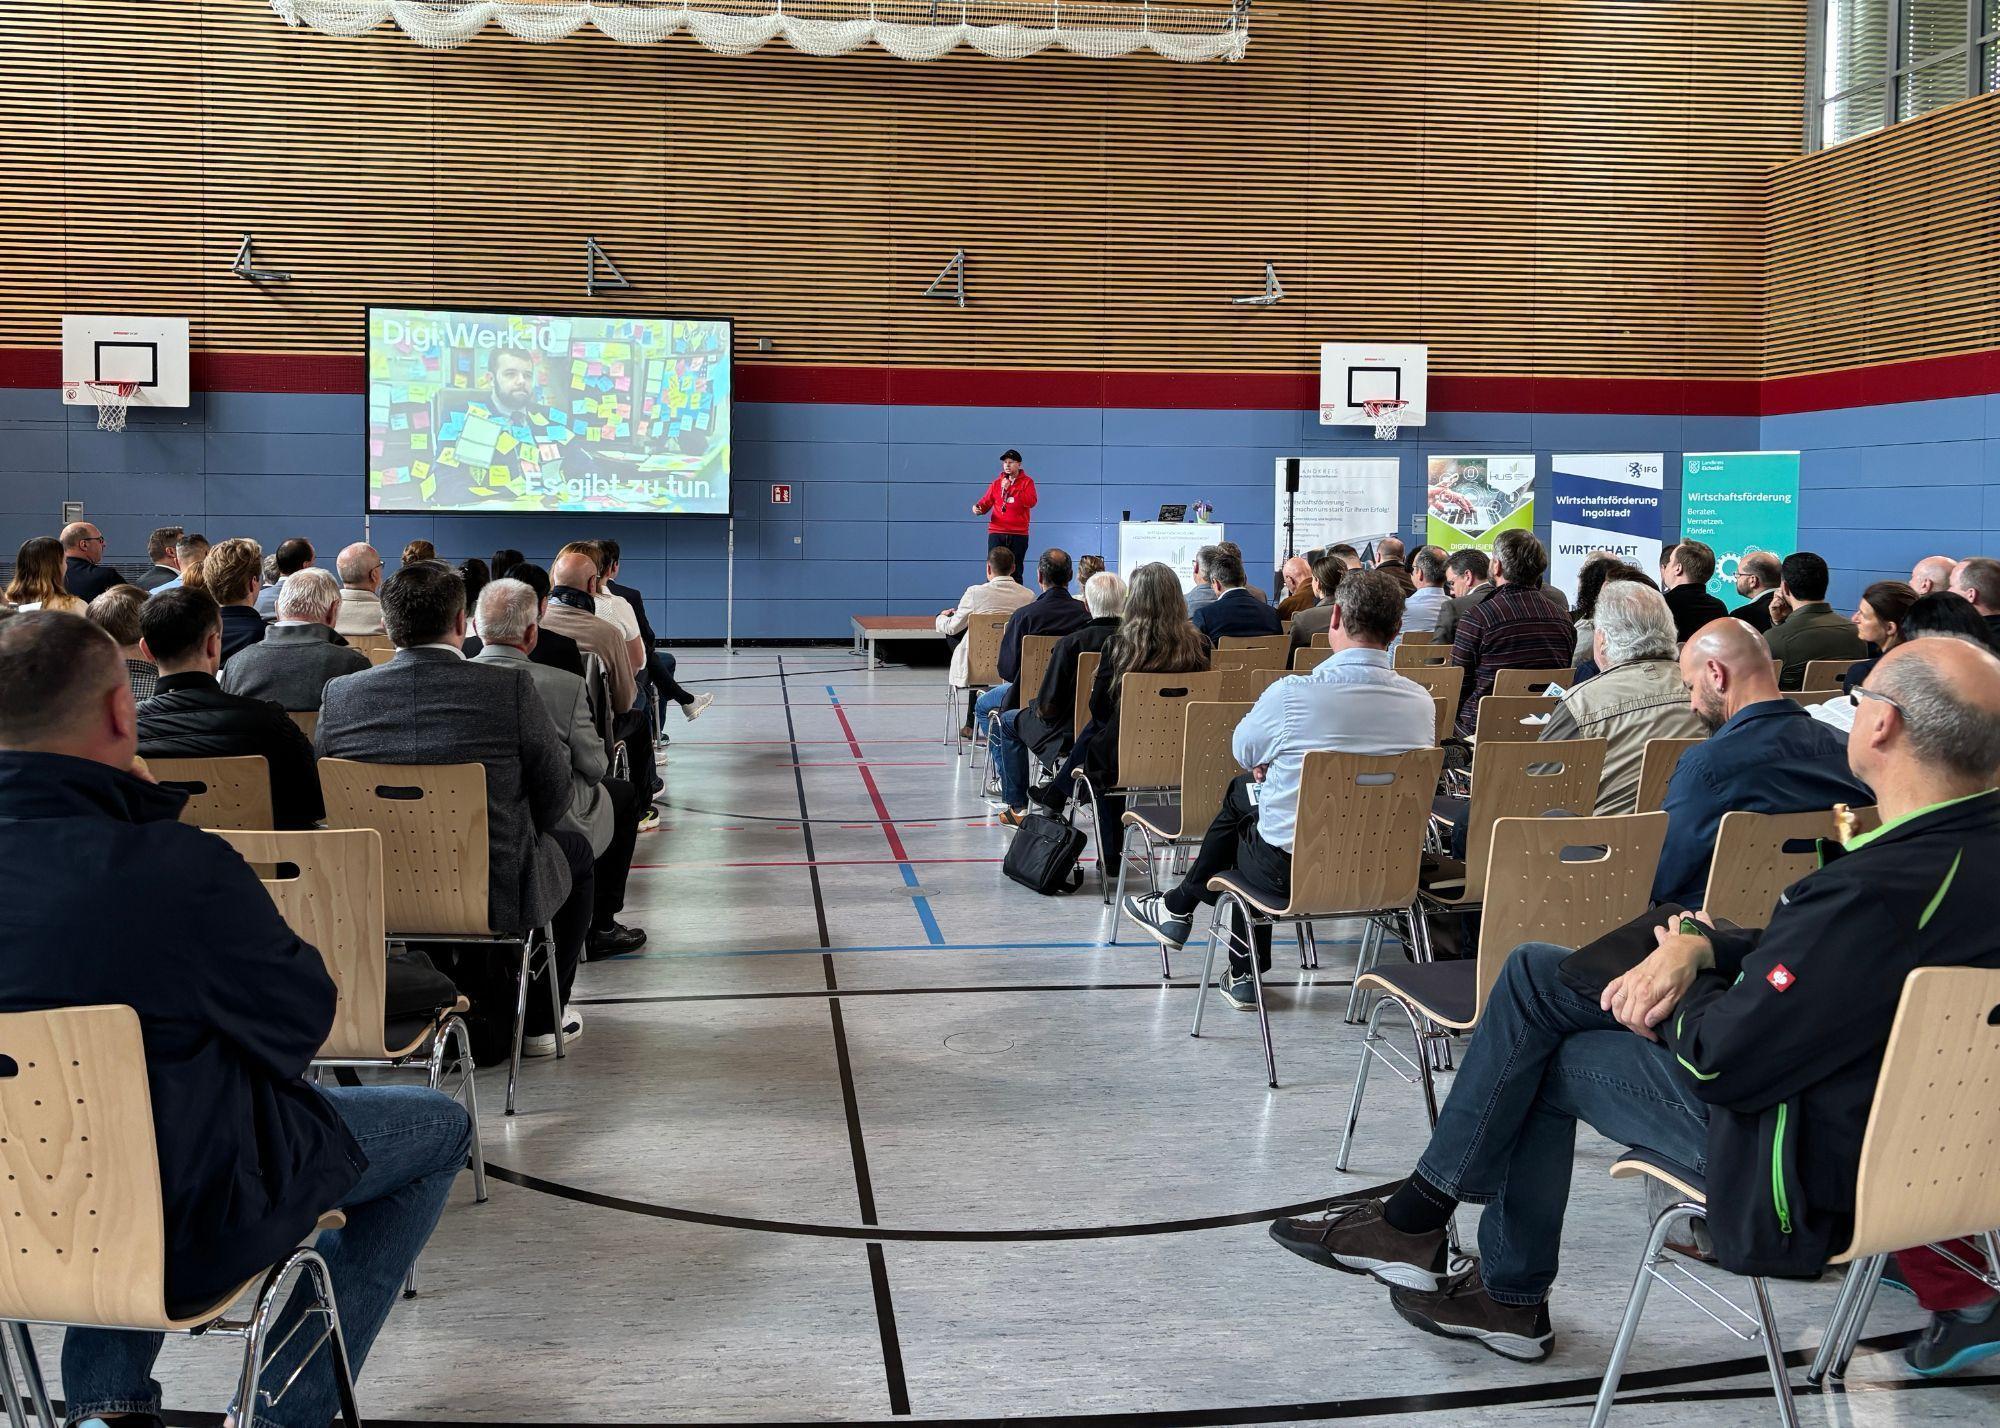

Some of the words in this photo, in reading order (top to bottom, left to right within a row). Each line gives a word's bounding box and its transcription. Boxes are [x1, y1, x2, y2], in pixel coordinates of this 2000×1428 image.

[525, 472, 557, 496] Es
[567, 473, 621, 500] gibt
[628, 479, 659, 497] zu
[667, 475, 716, 498] tun.
[1556, 495, 1658, 507] Wirtschaftsförderung
[1688, 492, 1792, 504] Wirtschaftsförderung
[1370, 506, 1390, 514] Erfolg!
[1582, 508, 1631, 519] Ingolstadt
[1687, 527, 1716, 535] Fördern.
